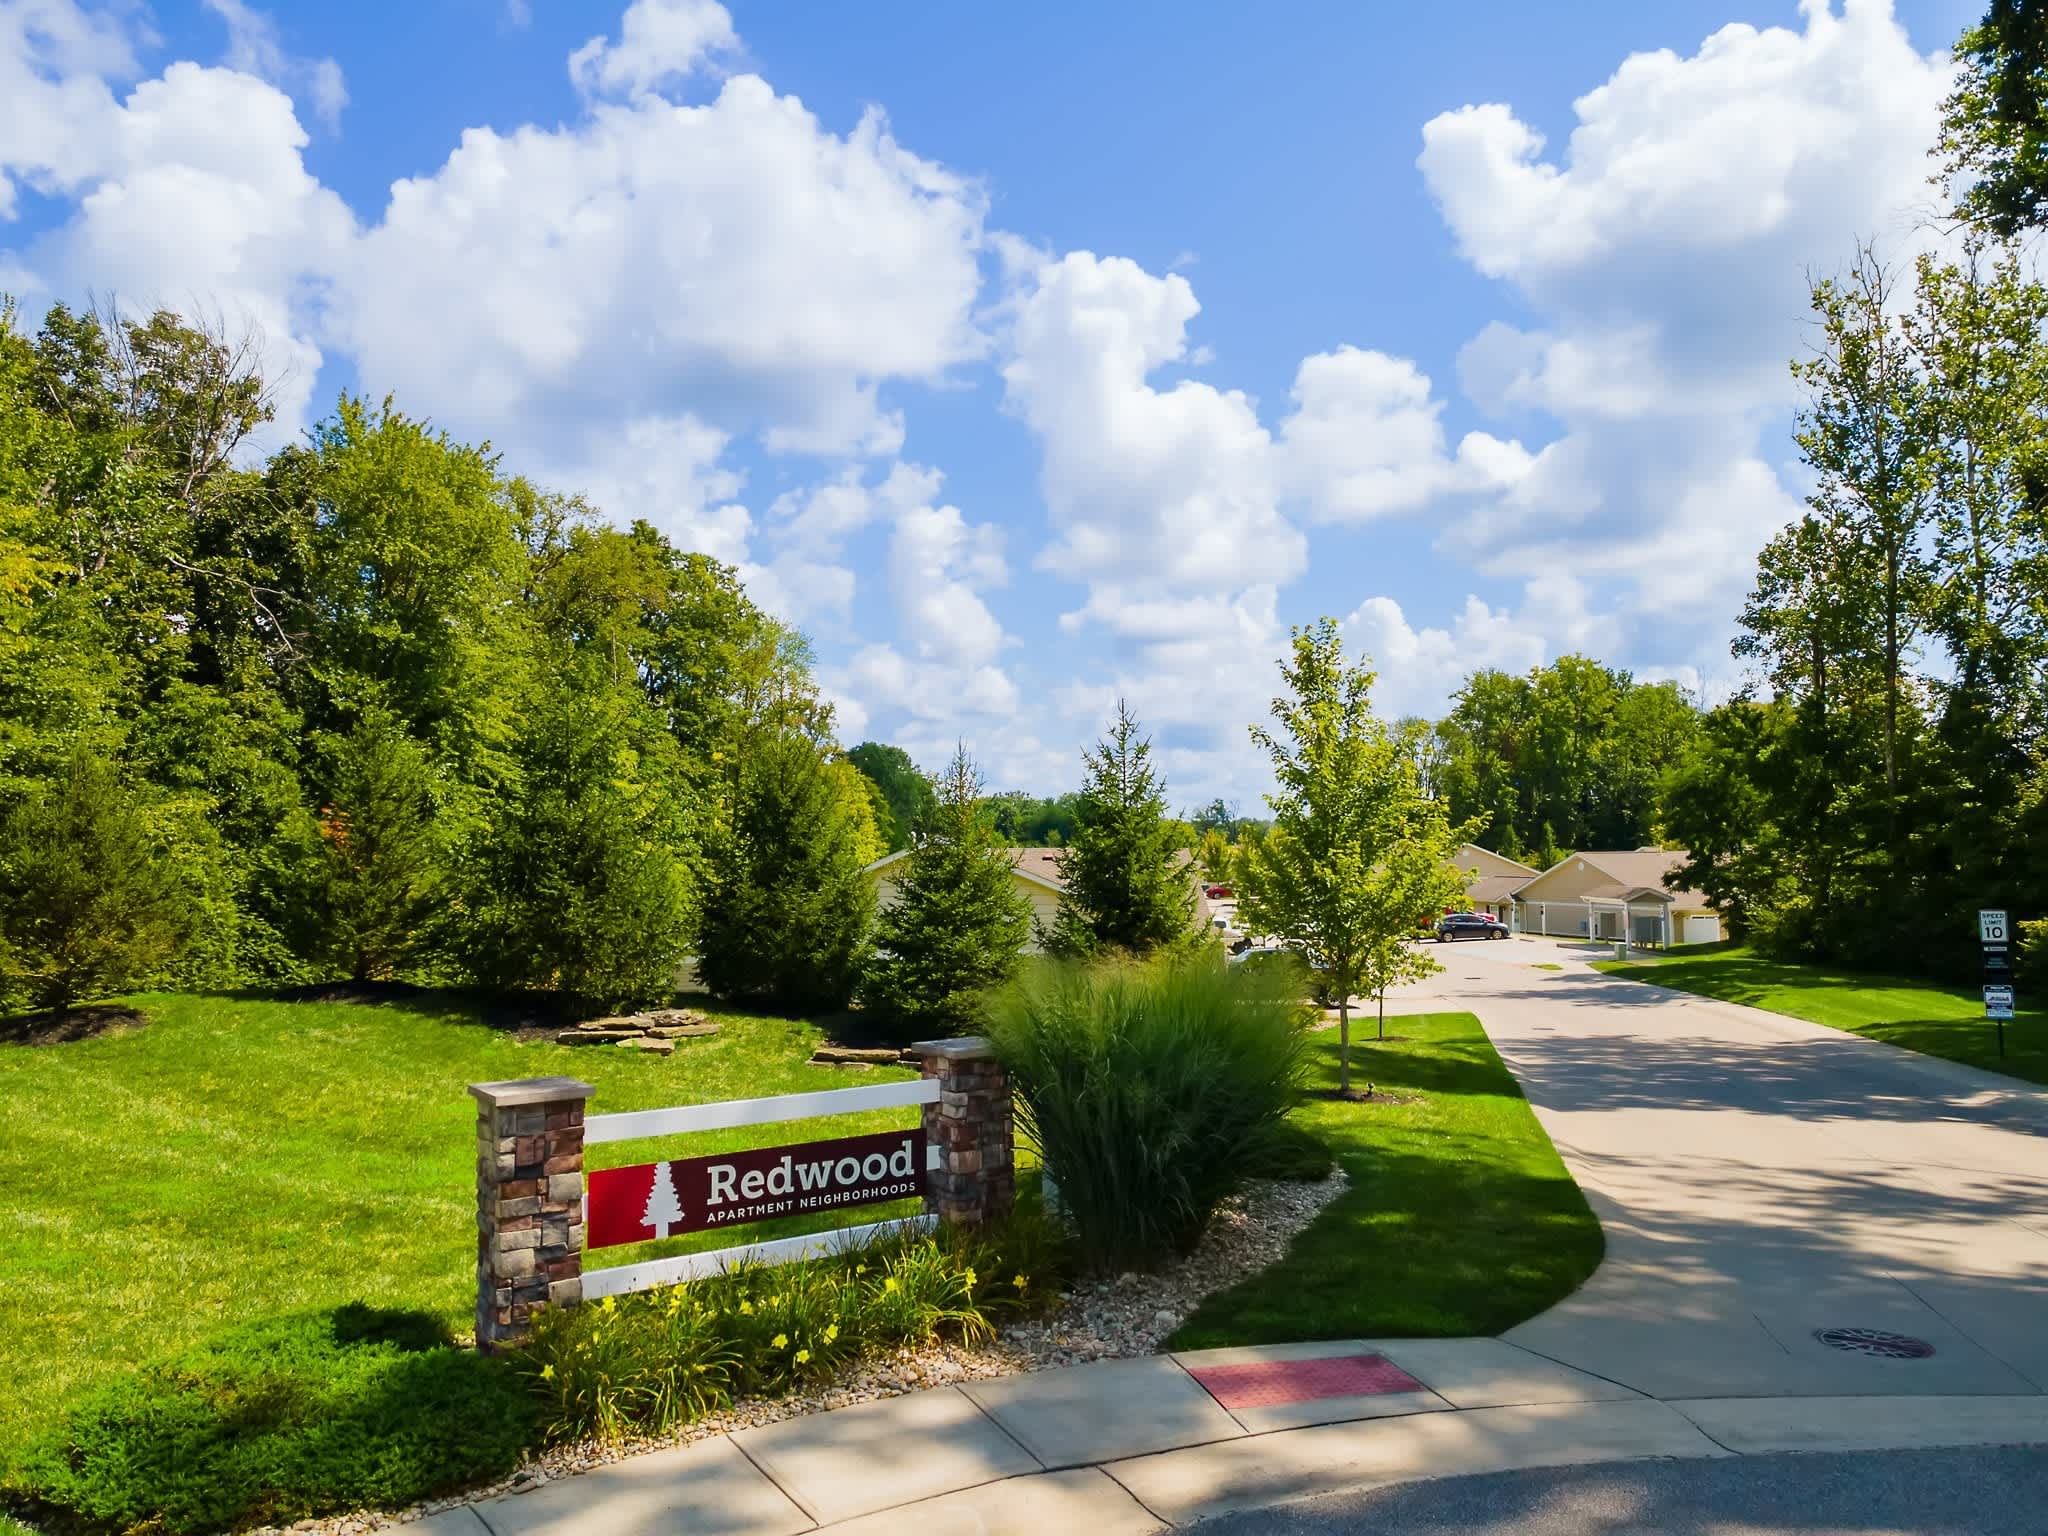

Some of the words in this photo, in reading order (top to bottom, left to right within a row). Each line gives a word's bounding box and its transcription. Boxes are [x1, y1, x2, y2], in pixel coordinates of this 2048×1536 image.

[1985, 926, 2003, 938] 10
[707, 1140, 915, 1206] Redwood
[707, 1200, 793, 1223] APARTMENT
[800, 1182, 916, 1208] NEIGHBORHOODS
